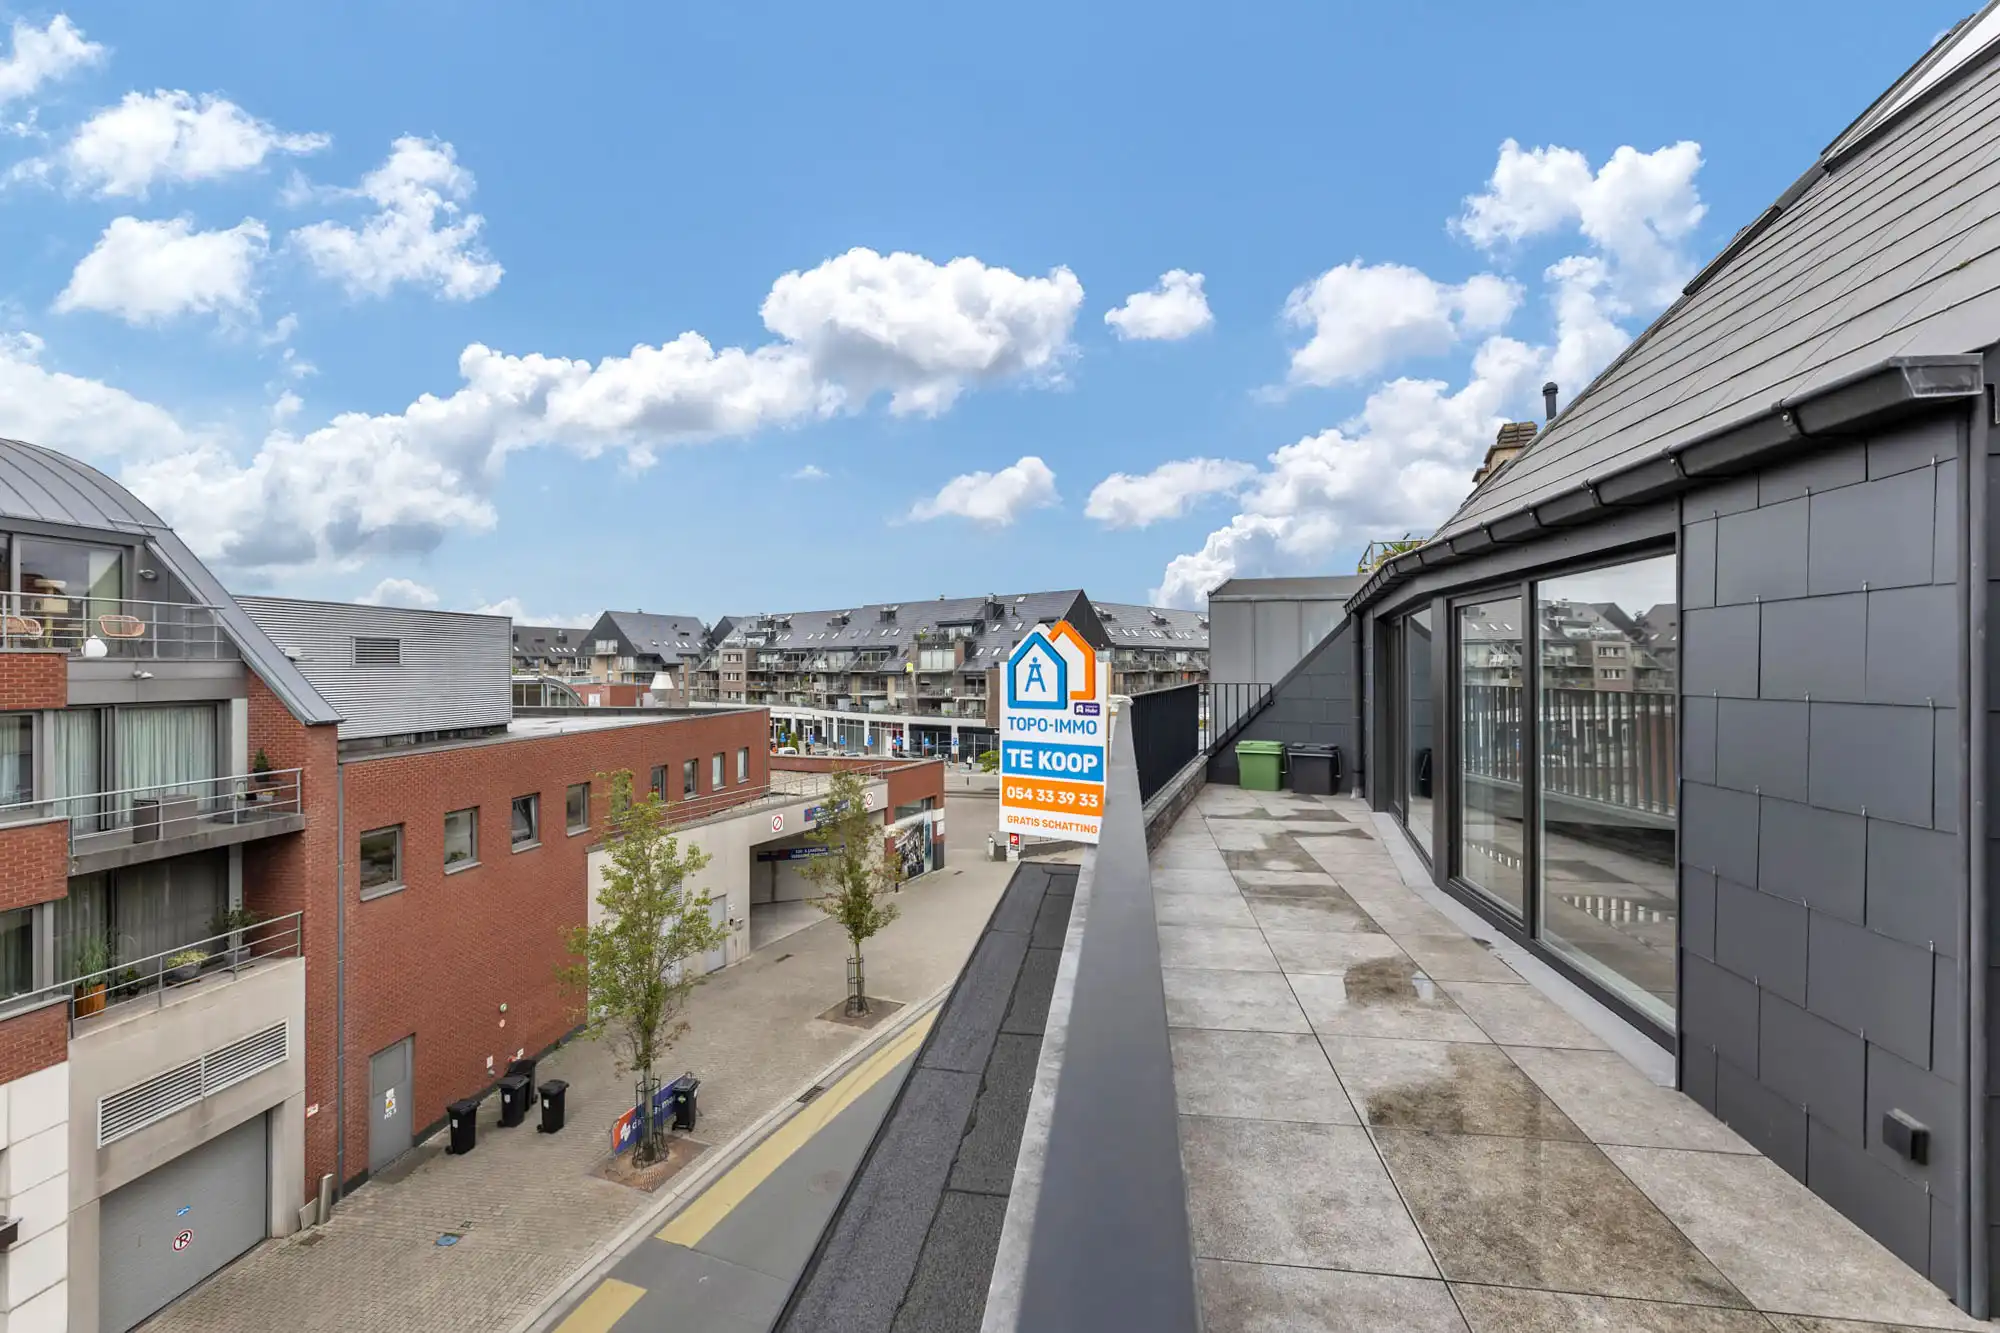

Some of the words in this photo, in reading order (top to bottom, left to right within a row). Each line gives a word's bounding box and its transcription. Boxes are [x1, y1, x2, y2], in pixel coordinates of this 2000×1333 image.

[1007, 716, 1097, 735] TOPO-IMMO
[1007, 748, 1033, 769] TE
[1038, 750, 1098, 773] KOOP
[1006, 786, 1033, 801] 054
[1036, 789, 1054, 803] 33
[1057, 791, 1076, 805] 39
[1078, 793, 1098, 807] 33
[1007, 815, 1040, 827] GRATIS
[1041, 818, 1098, 834] SCHATTING
